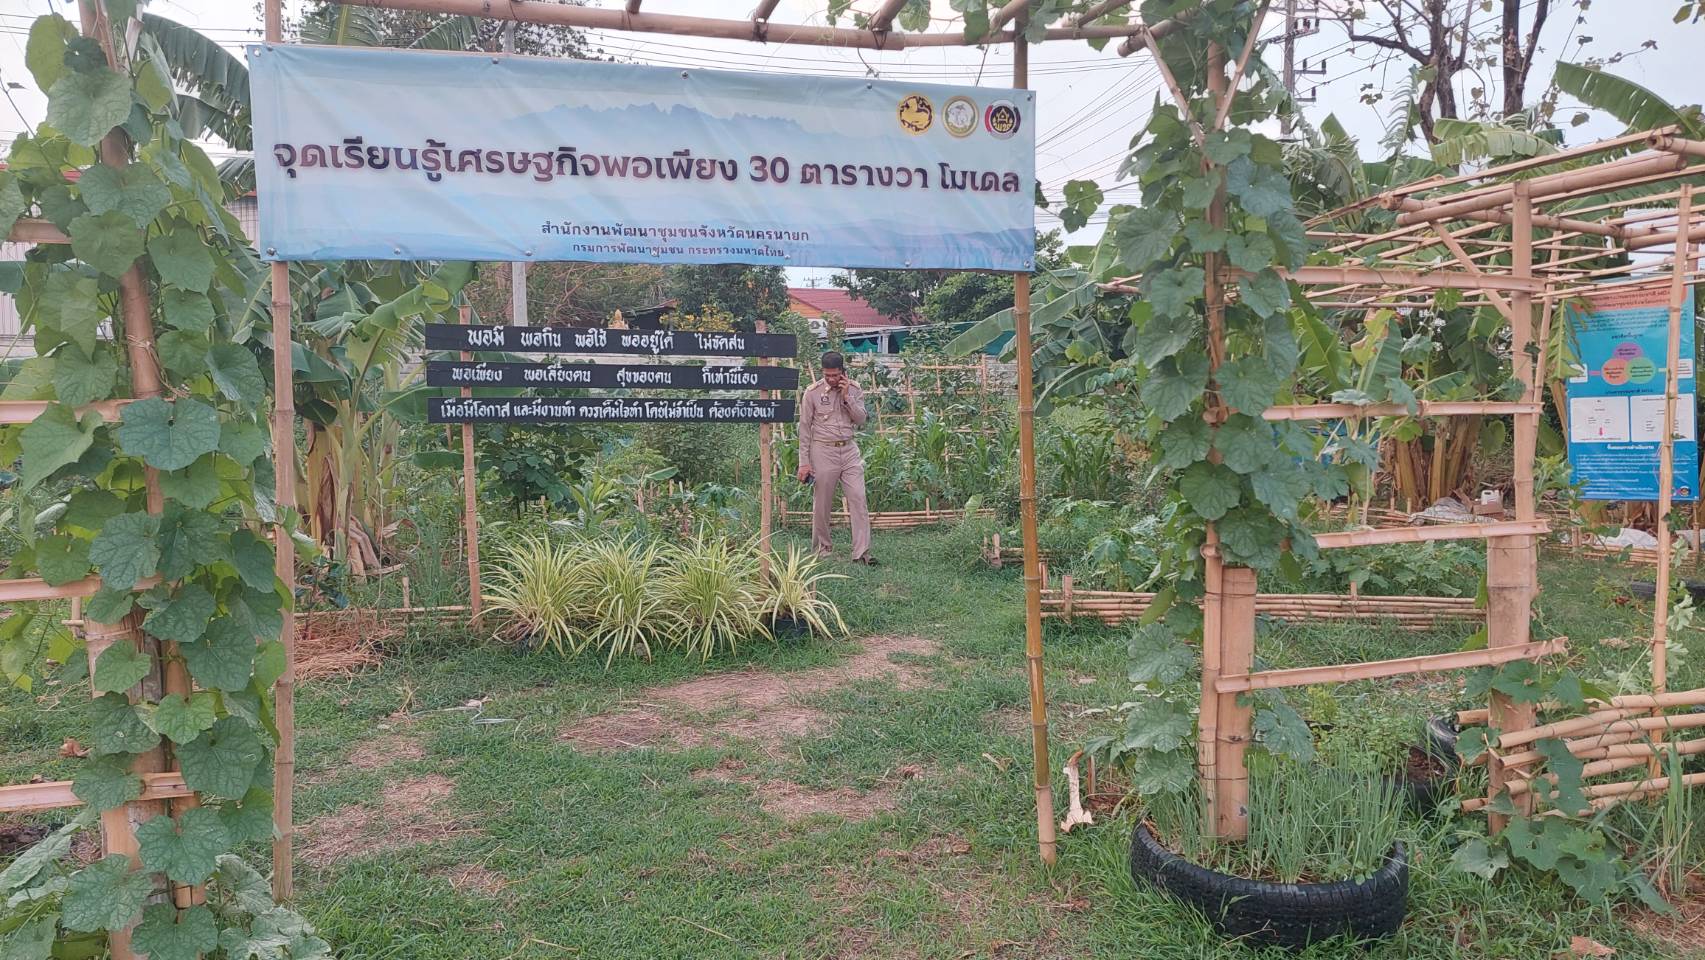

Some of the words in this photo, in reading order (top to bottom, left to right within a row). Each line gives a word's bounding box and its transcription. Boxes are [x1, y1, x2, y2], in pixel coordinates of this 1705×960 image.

[273, 136, 738, 182] จุดเรียนรู้เศรษฐกิจพอเพียง
[749, 156, 790, 184] 30
[800, 162, 929, 189] ตารางวา
[938, 162, 1021, 193] โมเดล
[541, 220, 809, 242] สำนักงานพัฒนาชุมชนจังหวัดนครนายก
[688, 245, 785, 257] กระทรวงมหาดไทย
[467, 325, 505, 347] พอมี
[520, 327, 562, 347] พอกิน
[574, 327, 607, 348] พอใช้
[621, 329, 674, 354] พออยู่ได้
[452, 362, 503, 382] พอเพียง
